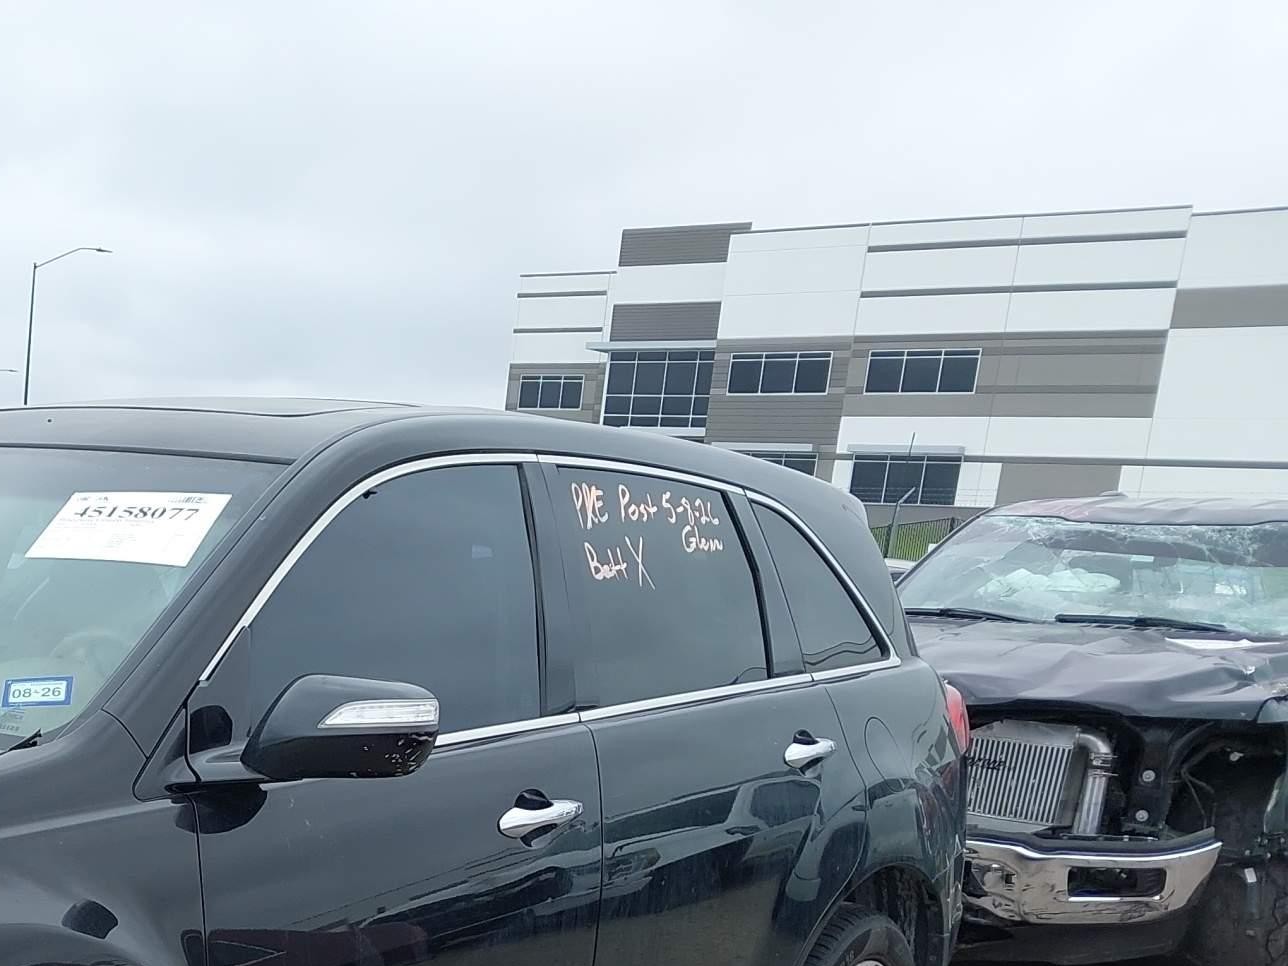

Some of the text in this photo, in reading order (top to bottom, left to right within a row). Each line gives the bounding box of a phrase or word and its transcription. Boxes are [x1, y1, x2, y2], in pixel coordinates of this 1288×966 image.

[74, 505, 200, 521] 45158077
[571, 482, 609, 530] PRE
[618, 484, 658, 523] Post
[624, 535, 656, 591] X
[11, 686, 62, 699] 08-26
